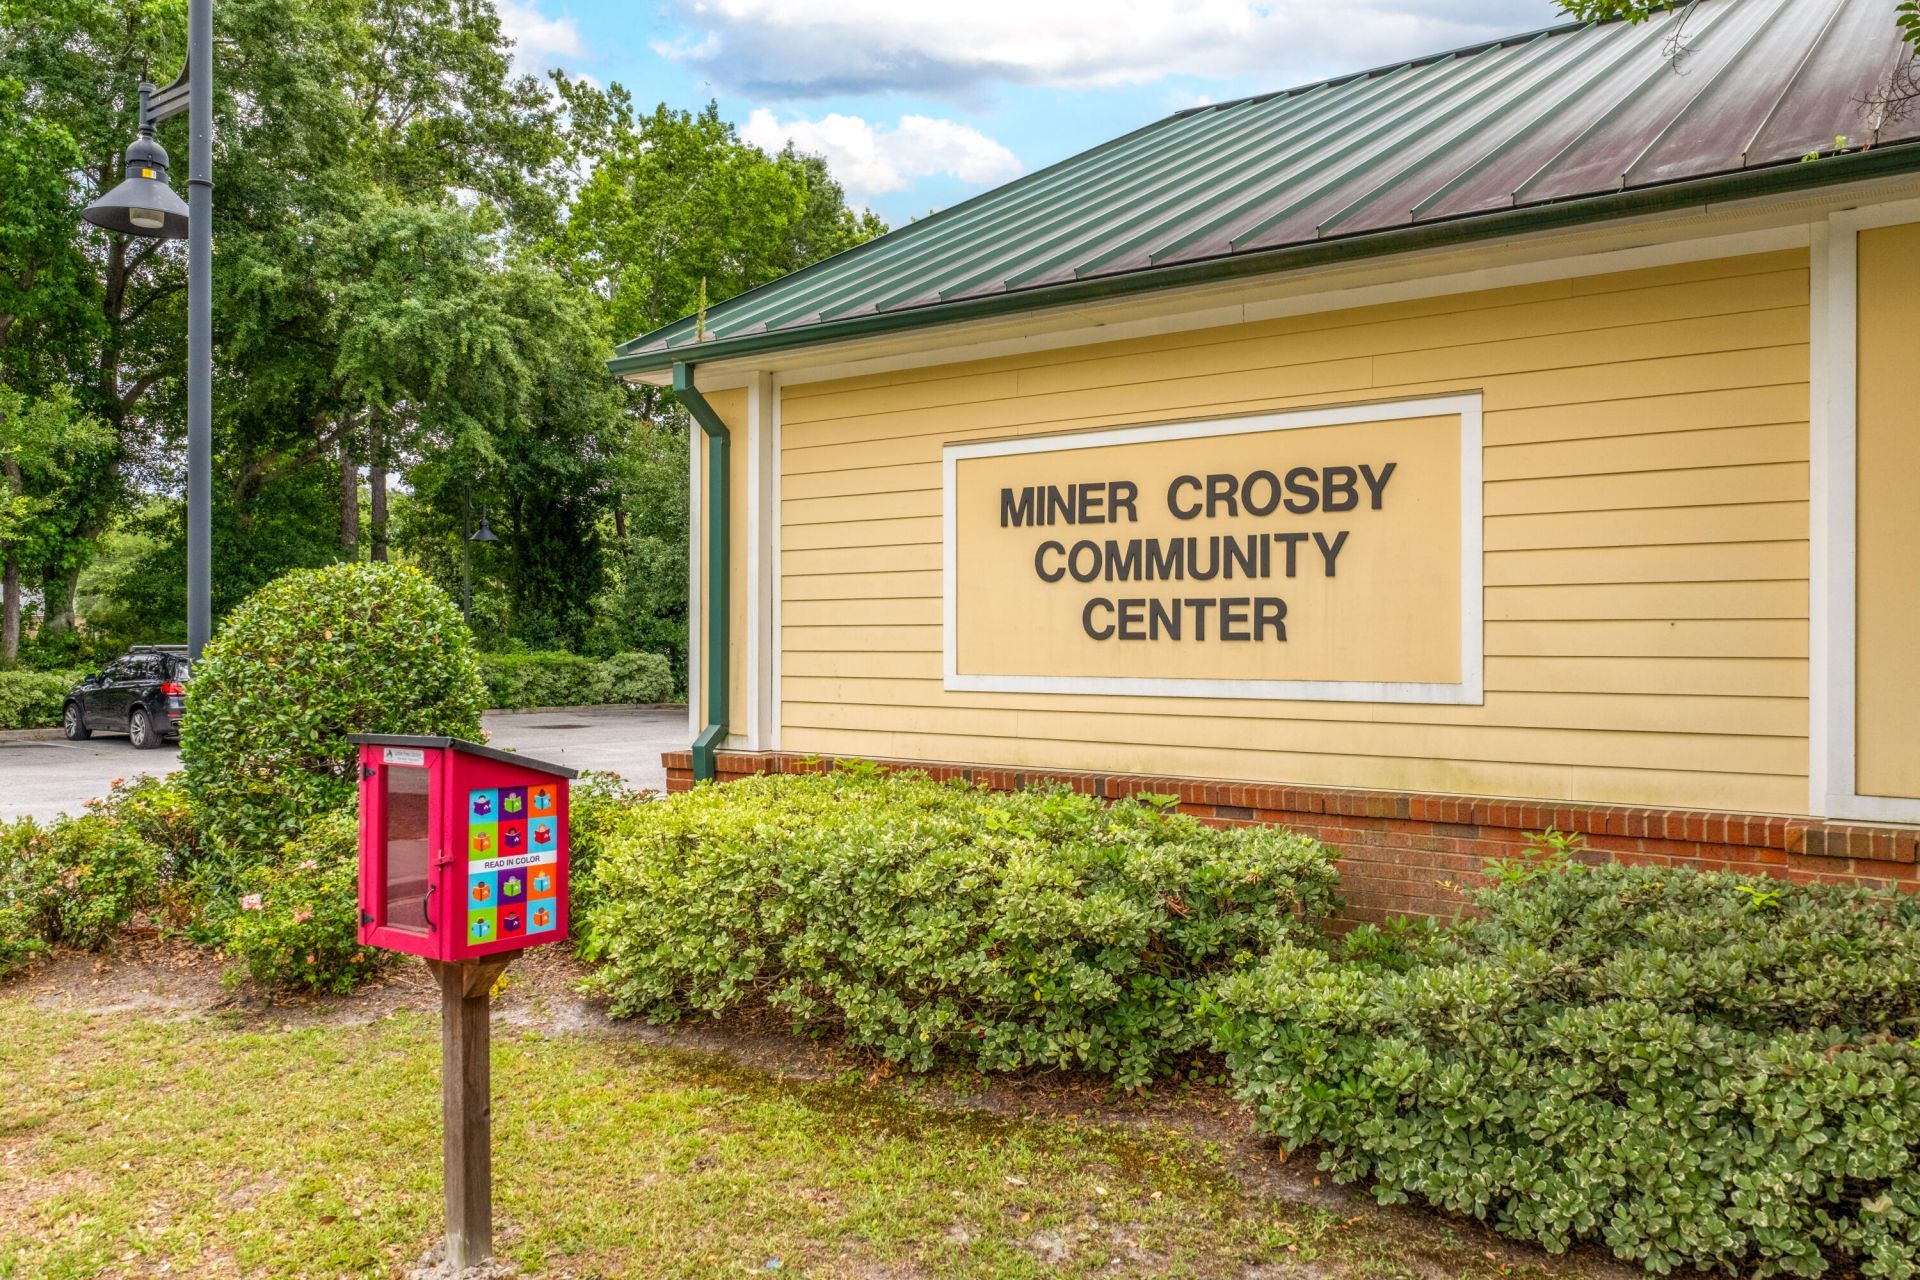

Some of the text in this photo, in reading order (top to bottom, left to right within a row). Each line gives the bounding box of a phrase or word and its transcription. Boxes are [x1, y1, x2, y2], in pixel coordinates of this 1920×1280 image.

[1000, 463, 1397, 528] MINER CROSBY
[1034, 531, 1349, 584] COMMUNITY
[1082, 597, 1288, 642] CENTER
[484, 861, 505, 869] READ
[515, 855, 540, 865] COLOR
